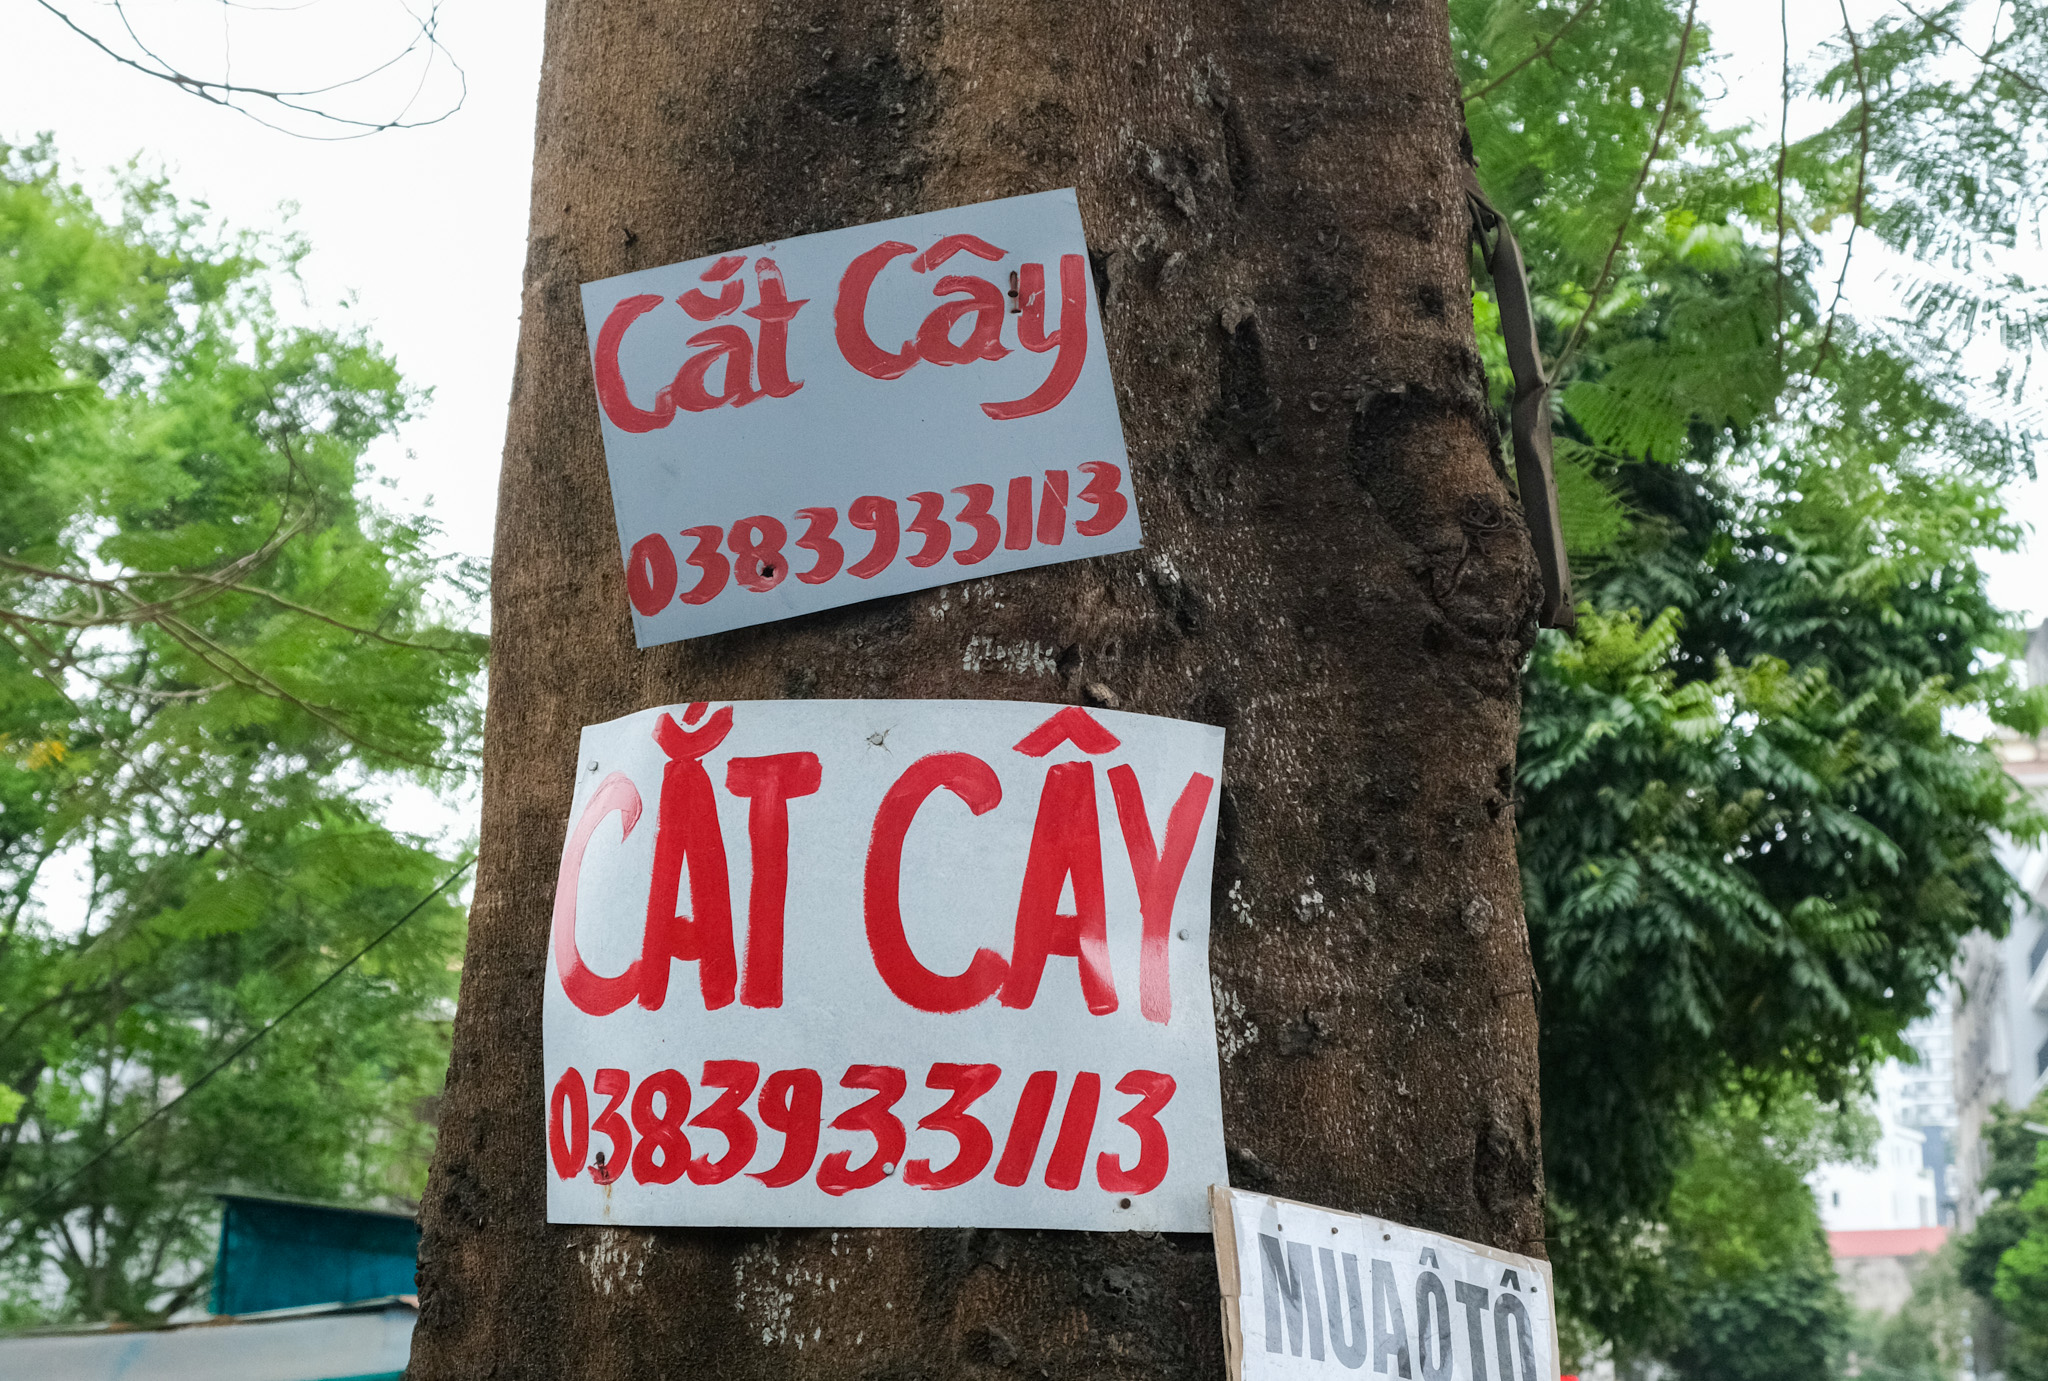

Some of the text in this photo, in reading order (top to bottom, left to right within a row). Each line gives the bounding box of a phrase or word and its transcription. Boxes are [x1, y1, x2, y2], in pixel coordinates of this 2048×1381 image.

[594, 233, 1088, 434] Cắt Cây
[626, 460, 1128, 617] 0383933113
[554, 702, 1213, 1026] CẮT CÂY
[549, 1059, 1177, 1197] 0383933113
